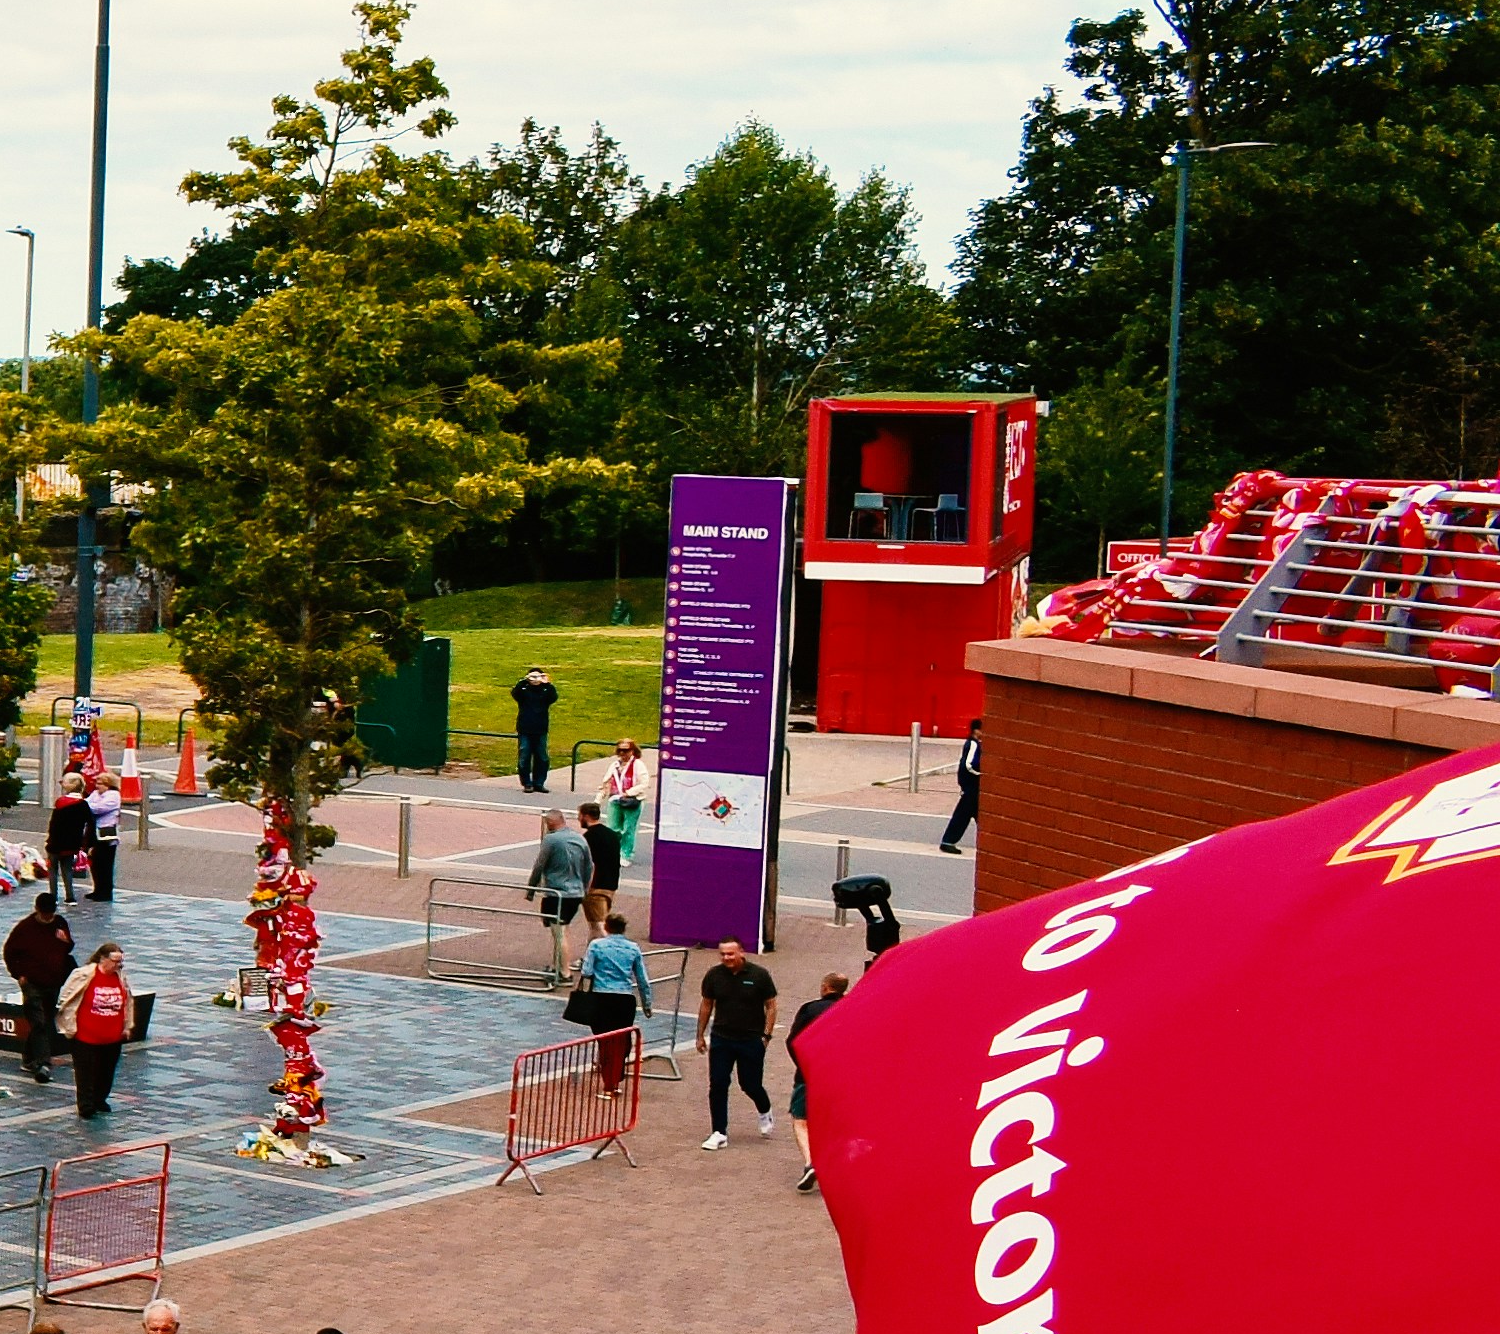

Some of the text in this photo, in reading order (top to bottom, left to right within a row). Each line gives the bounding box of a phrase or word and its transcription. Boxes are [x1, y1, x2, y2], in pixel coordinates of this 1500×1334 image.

[683, 525, 769, 540] MAIN STAND
[1117, 552, 1162, 563] OFFICIA
[1021, 884, 1154, 972] to
